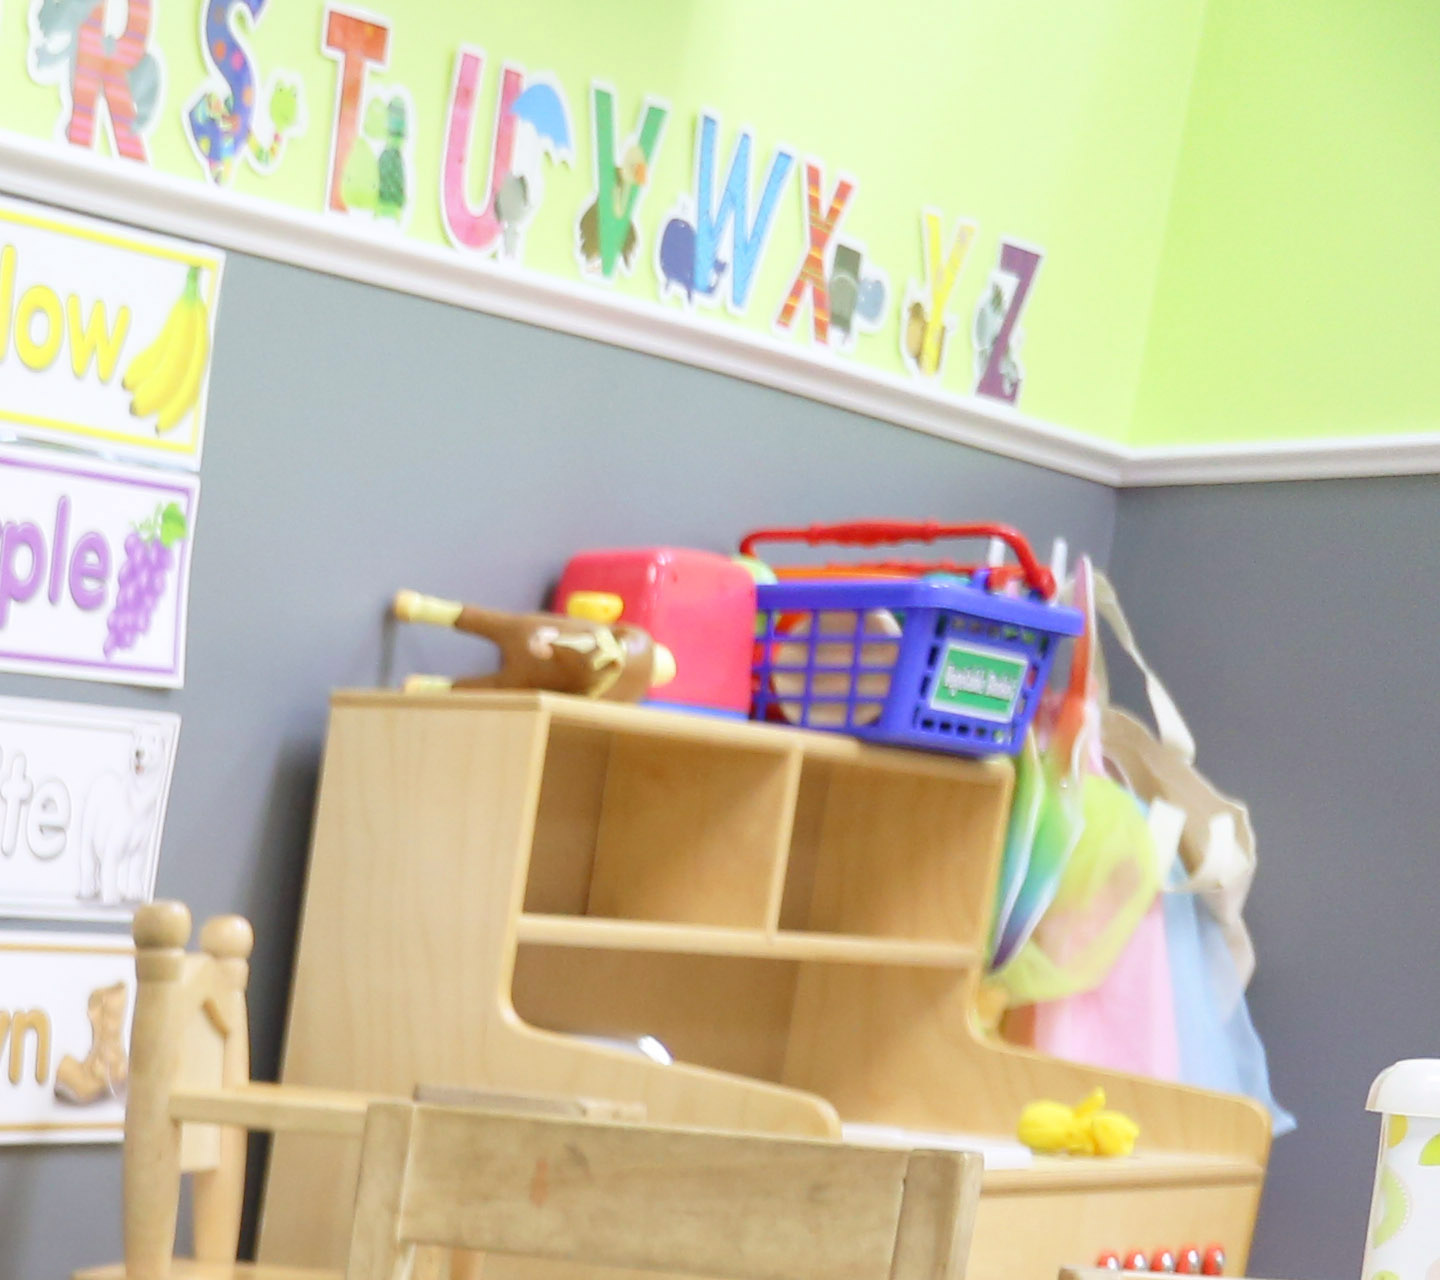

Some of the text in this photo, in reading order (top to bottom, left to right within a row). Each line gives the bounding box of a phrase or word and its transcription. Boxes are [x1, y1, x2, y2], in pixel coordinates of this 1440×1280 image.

[68, 0, 148, 160] R
[188, 0, 267, 180] S
[325, 10, 390, 212] T
[442, 52, 525, 247] U
[592, 88, 668, 278] V
[696, 115, 792, 308] W
[777, 162, 854, 342] X
[920, 212, 976, 374] Y
[976, 240, 1043, 405] Z
